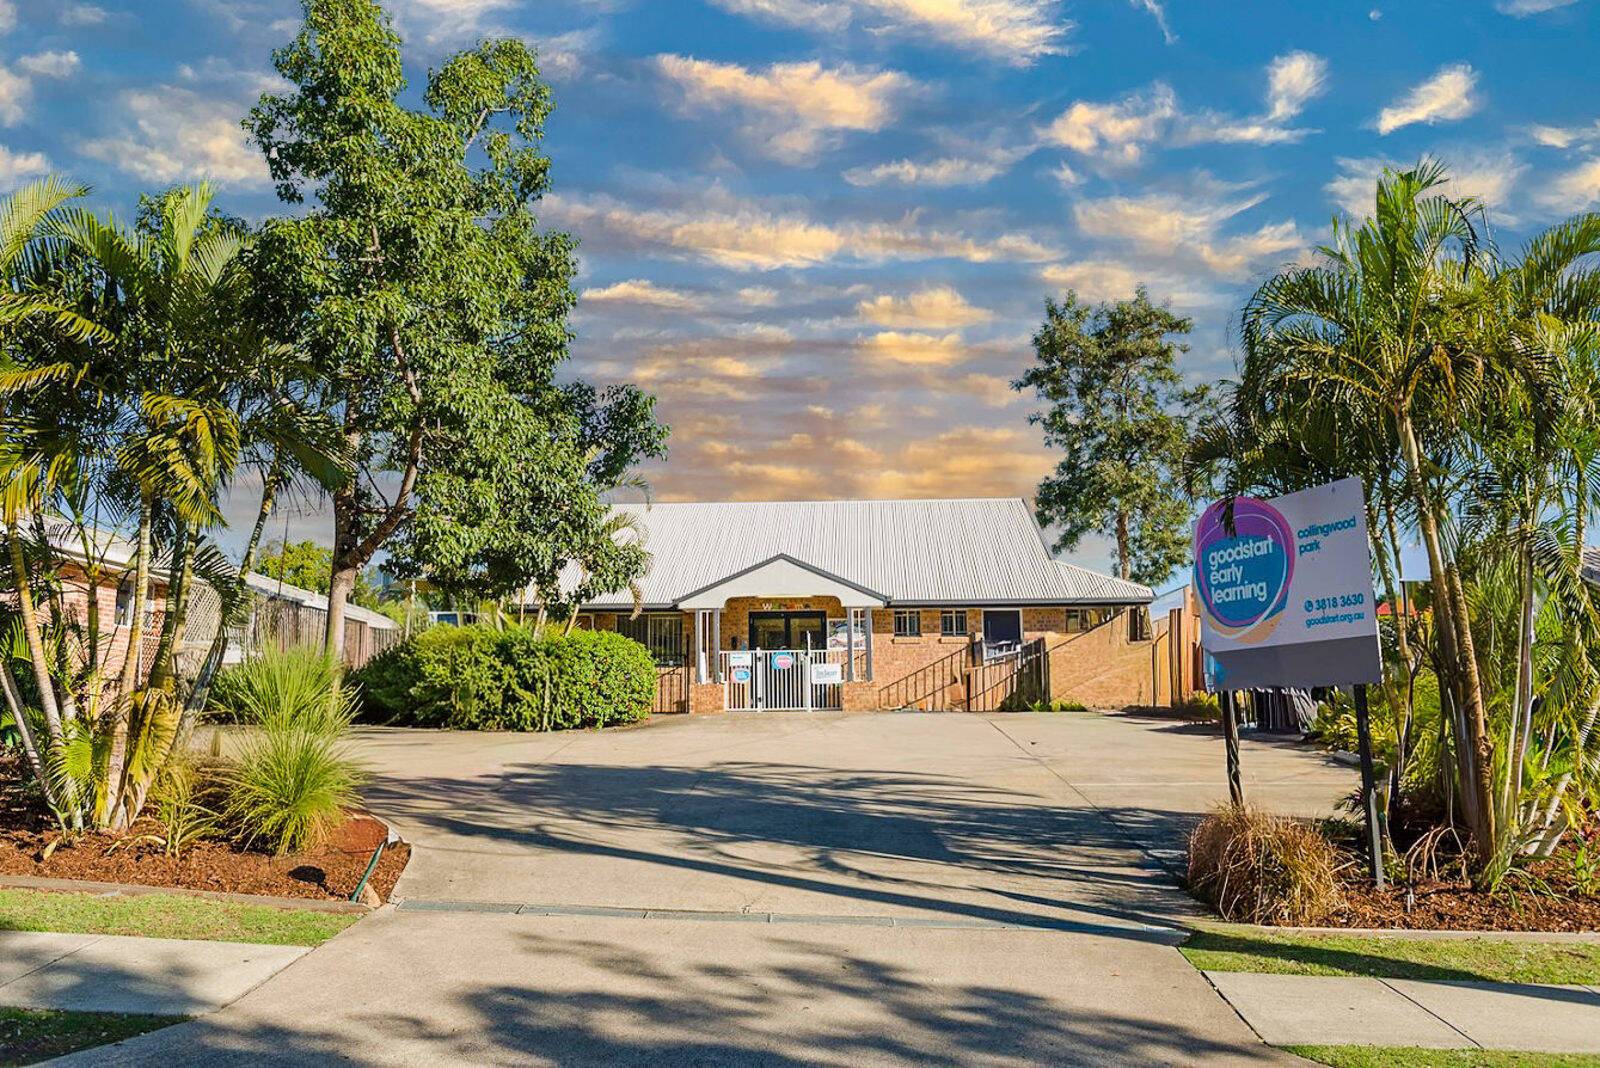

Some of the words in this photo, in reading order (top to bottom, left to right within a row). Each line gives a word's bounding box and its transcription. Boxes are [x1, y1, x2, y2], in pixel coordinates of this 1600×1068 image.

[1298, 515, 1356, 539] collingwood
[1209, 534, 1273, 570] goodstart
[1299, 539, 1321, 557] park
[1211, 563, 1243, 585] early
[1212, 580, 1267, 604] learning
[1315, 596, 1338, 611] 3818
[1340, 592, 1364, 607] 3630
[1305, 612, 1365, 629] goodstart.org.au
